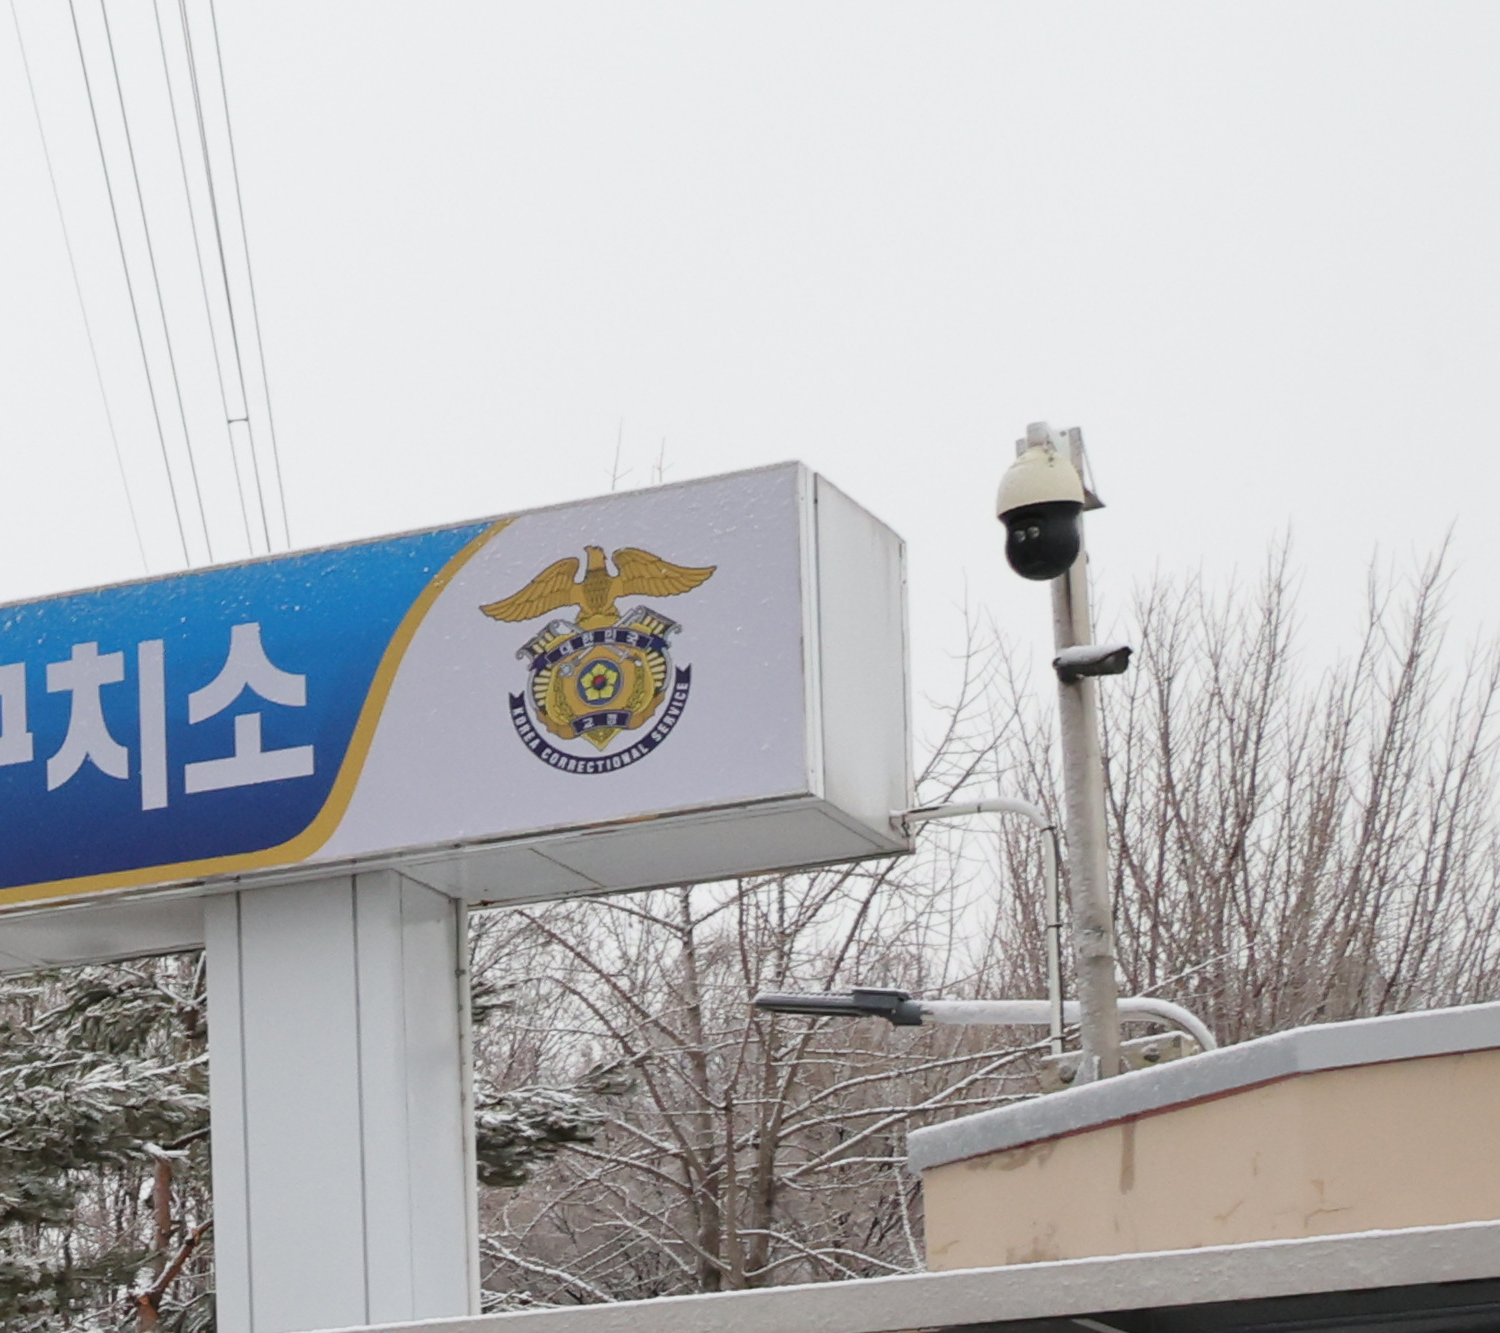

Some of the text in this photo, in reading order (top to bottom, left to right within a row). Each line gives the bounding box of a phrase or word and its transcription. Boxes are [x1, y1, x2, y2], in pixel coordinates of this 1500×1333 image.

[512, 682, 690, 774] KOREA CORRECTIONAL SERVICE
